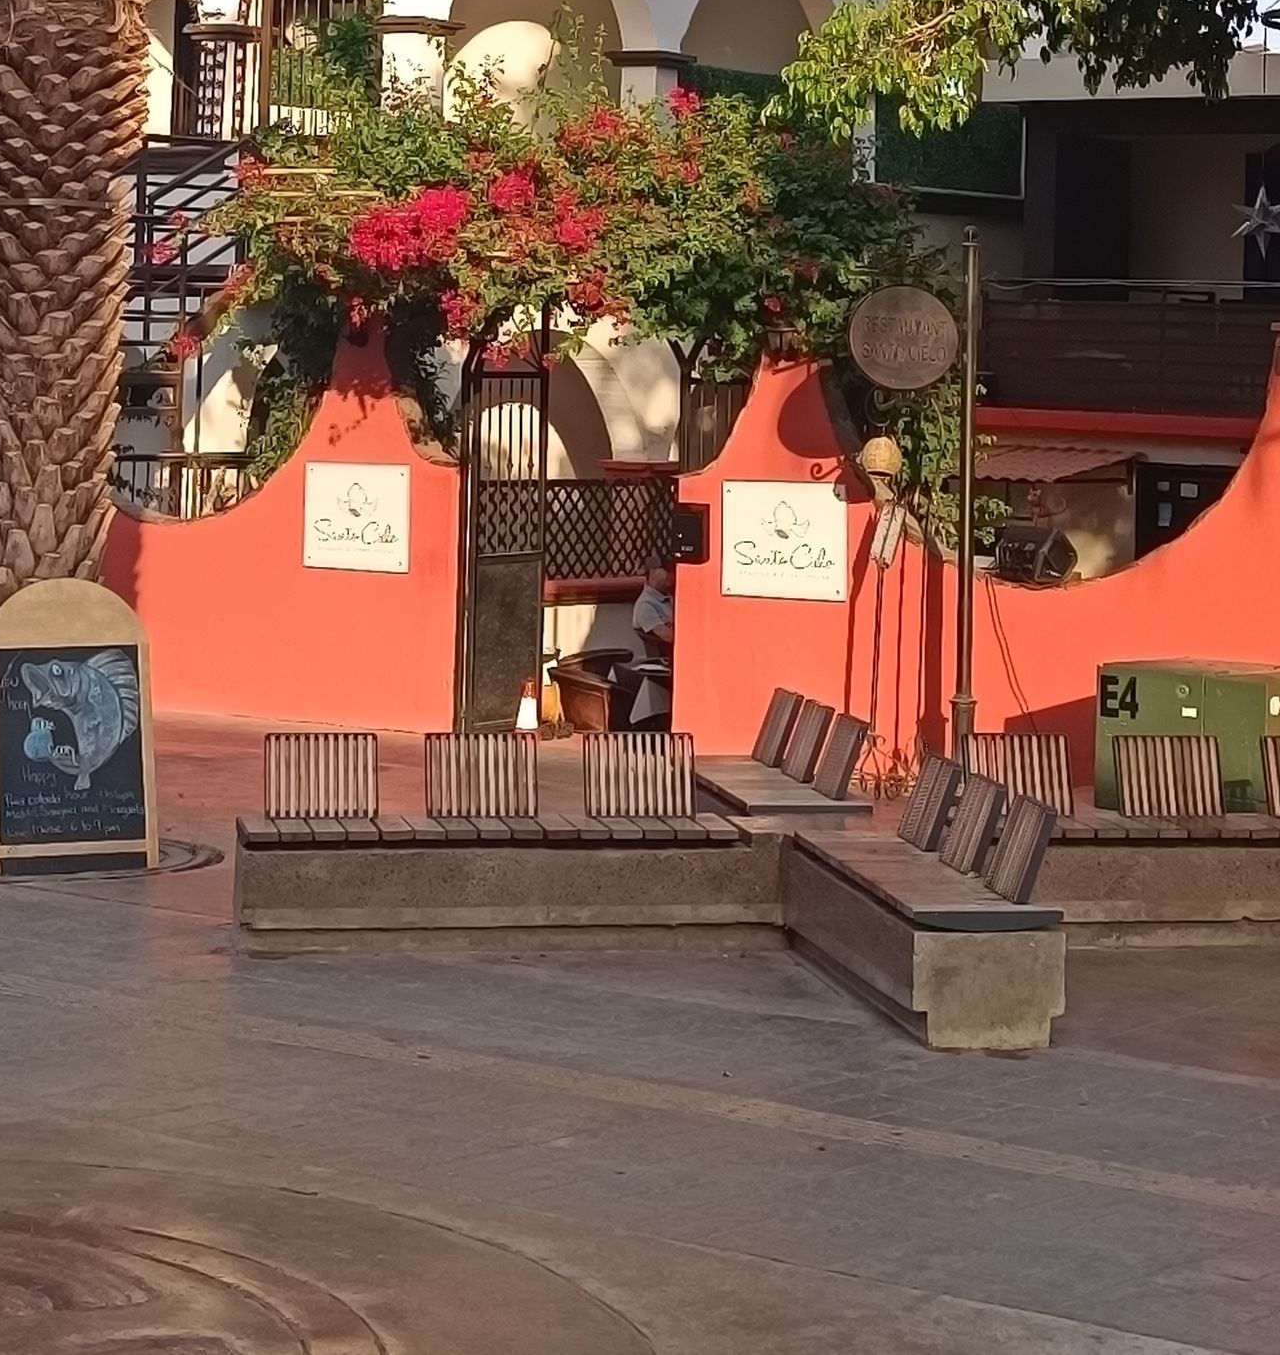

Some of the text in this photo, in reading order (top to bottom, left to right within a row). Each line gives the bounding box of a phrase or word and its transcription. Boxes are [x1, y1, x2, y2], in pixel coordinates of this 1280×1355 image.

[862, 341, 948, 363] SANTO CIELO
[1100, 674, 1139, 719] E4
[22, 764, 57, 787] Happy
